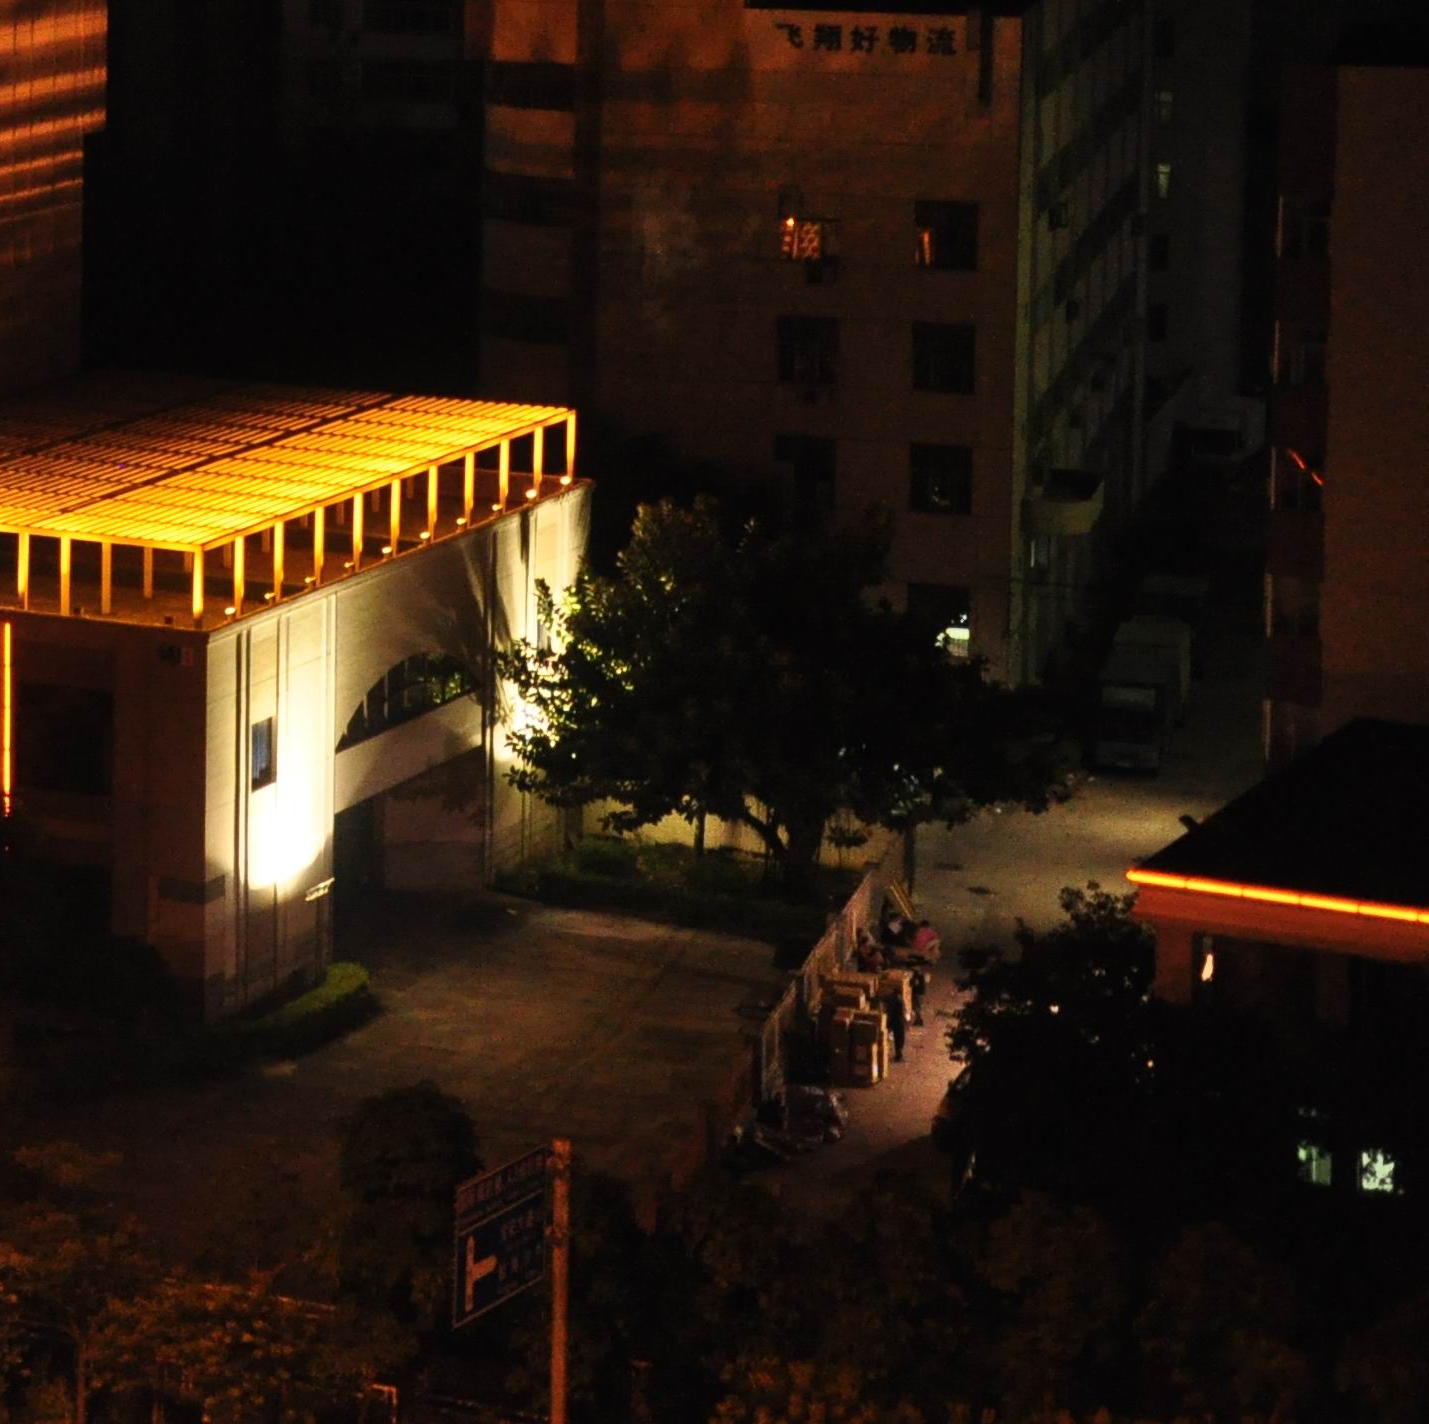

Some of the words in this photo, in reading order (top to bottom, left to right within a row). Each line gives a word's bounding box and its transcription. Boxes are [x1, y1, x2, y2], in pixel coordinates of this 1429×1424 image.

[773, 22, 957, 56] 飞翔好物流
